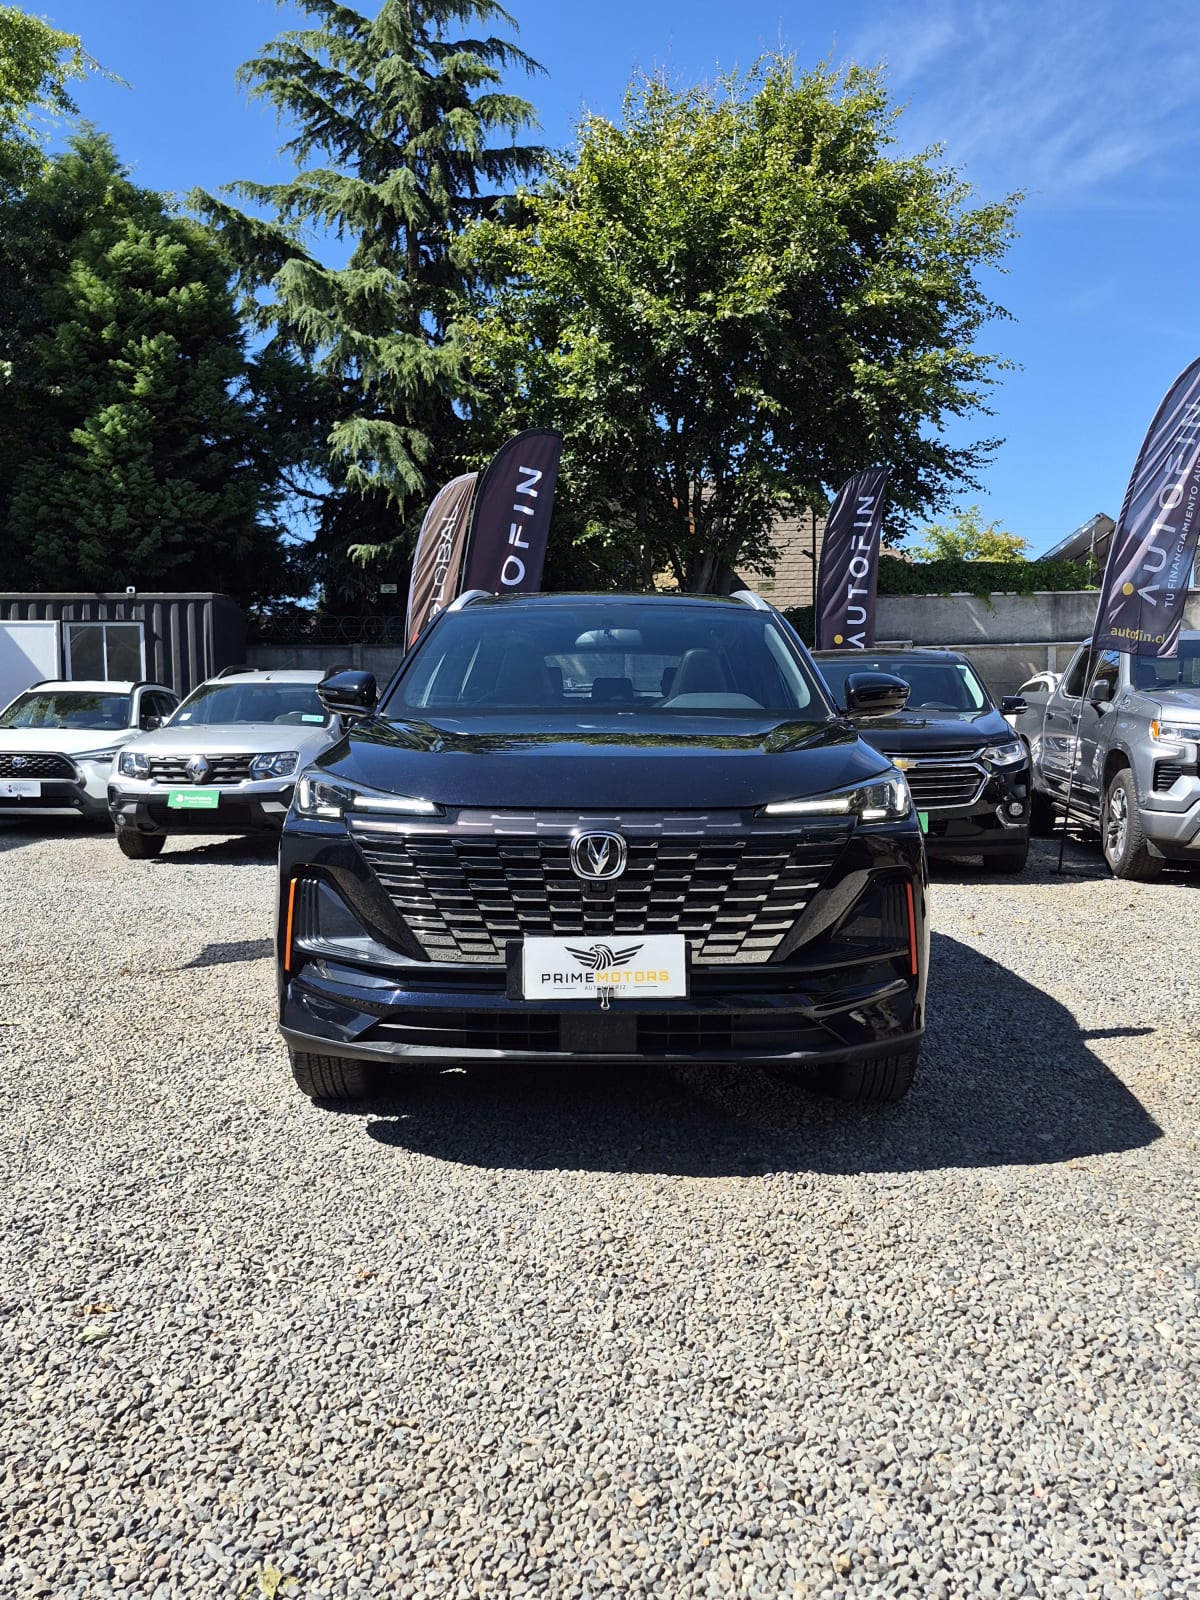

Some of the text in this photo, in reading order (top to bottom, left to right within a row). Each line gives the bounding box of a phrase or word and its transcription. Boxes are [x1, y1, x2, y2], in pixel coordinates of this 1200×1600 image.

[495, 466, 542, 595] OFIN
[1138, 403, 1200, 607] AUTOFIN
[1167, 486, 1198, 590] FINANCIAMIENTO
[846, 496, 875, 650] AUTOFIN
[1164, 593, 1176, 608] TU
[1110, 626, 1166, 645] autofin.cl
[541, 970, 669, 984] PRIMEMOTORS
